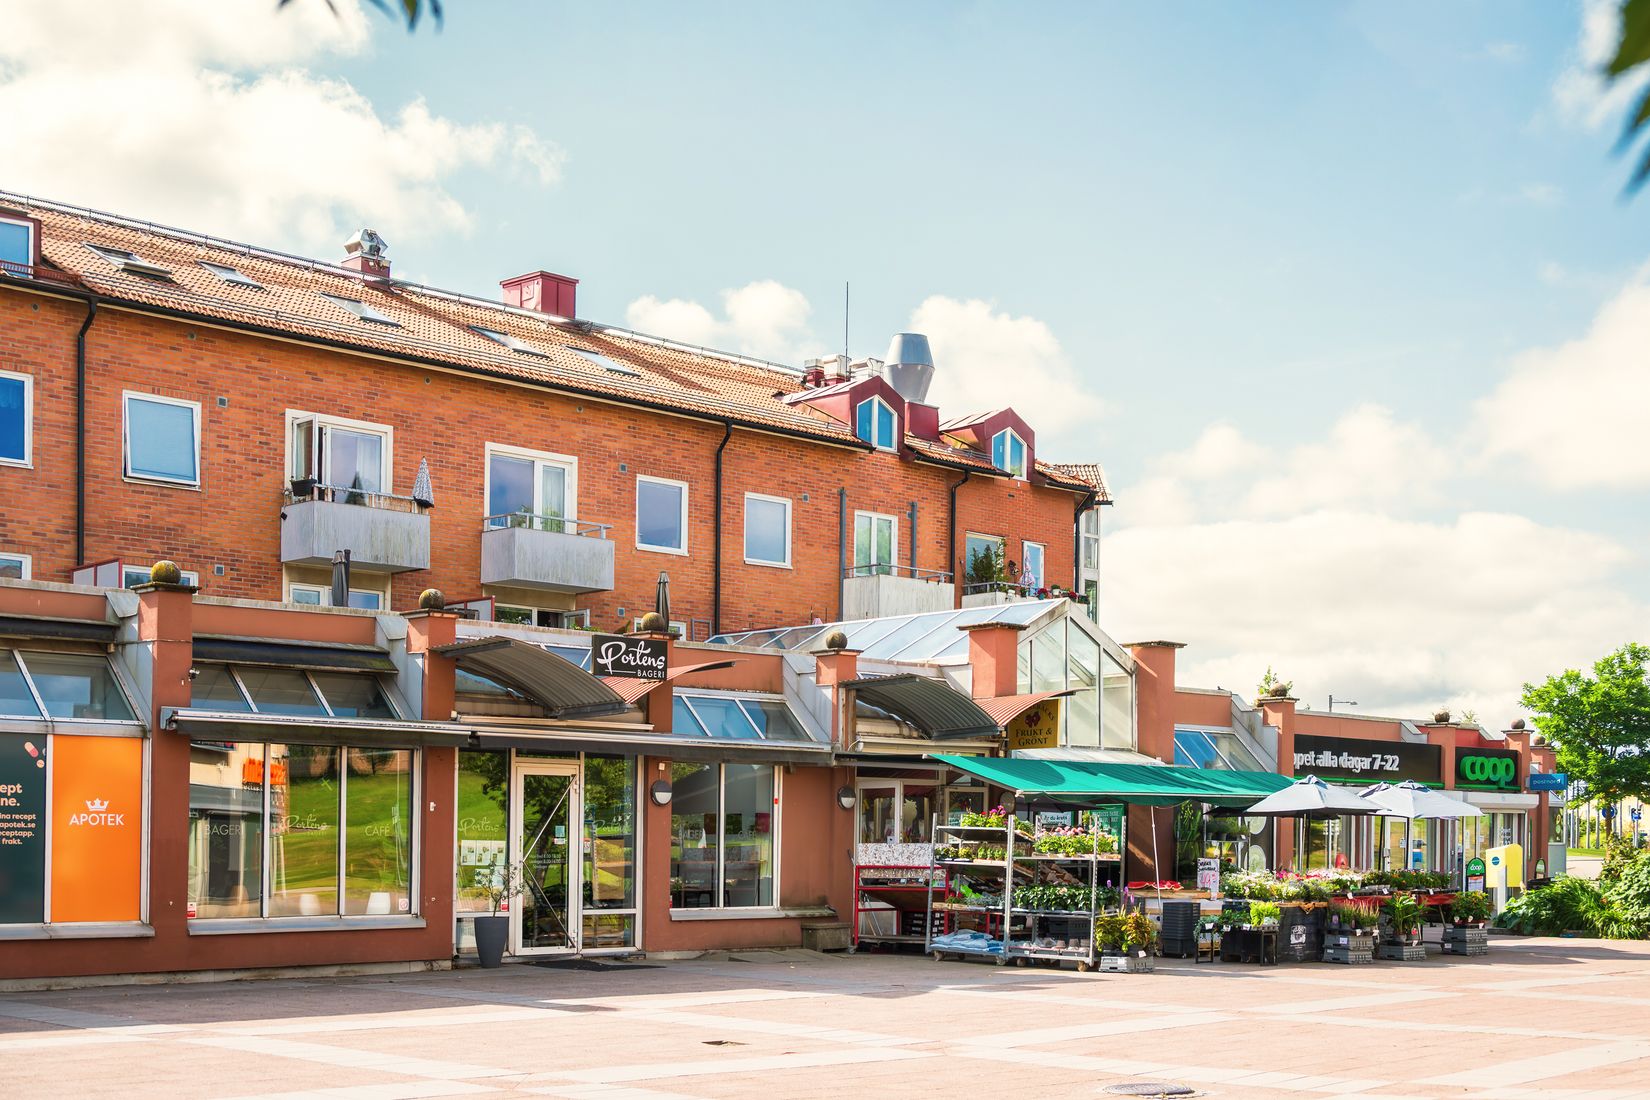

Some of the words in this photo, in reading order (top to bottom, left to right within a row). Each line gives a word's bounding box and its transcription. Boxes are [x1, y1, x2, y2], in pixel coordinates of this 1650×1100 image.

[596, 641, 666, 675] Portens
[637, 669, 665, 678] BAGERI
[1015, 729, 1043, 738] FRUKT
[1045, 727, 1053, 736] &
[1316, 750, 1338, 768] alla
[1339, 752, 1373, 773] dagar
[1372, 754, 1399, 771] 7-22
[1461, 756, 1515, 788] coop
[12, 813, 37, 821] recept
[69, 813, 125, 826] APOTEK
[204, 824, 241, 836] BAGER
[364, 824, 391, 836] CAFÉ
[457, 816, 500, 836] Portens
[2, 837, 23, 845] frakt.
